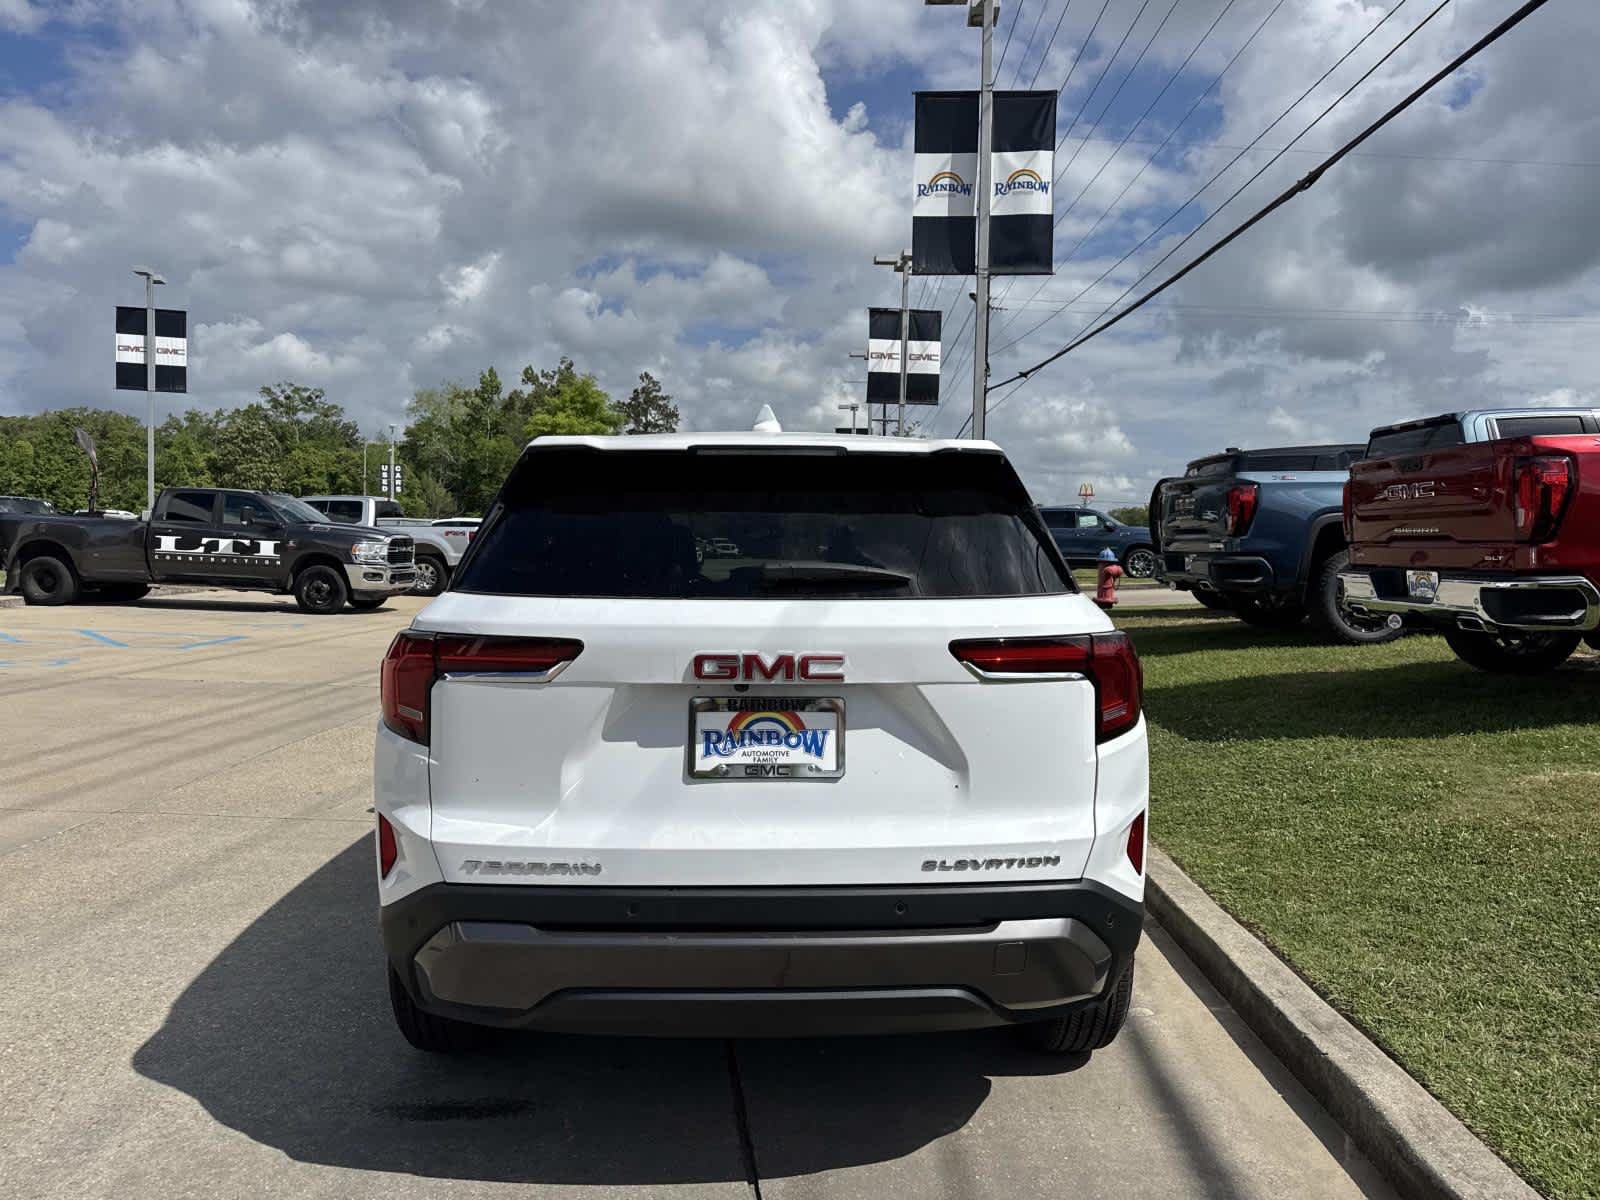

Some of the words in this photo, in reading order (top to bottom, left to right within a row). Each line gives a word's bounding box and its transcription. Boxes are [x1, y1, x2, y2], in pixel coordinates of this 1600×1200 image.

[917, 183, 973, 197] RAINBOW
[995, 181, 1050, 196] RAINBOW
[156, 347, 185, 356] GMC
[870, 352, 900, 360] GMC
[909, 353, 939, 361] GMC
[381, 464, 389, 492] USED
[1385, 481, 1435, 500] GMC
[154, 535, 281, 557] LTI
[693, 653, 845, 682] GMC
[702, 728, 830, 760] RAINBOW
[744, 764, 789, 776] GMC
[458, 860, 602, 876] TERRAIN
[921, 855, 1060, 872] ELEVATION
